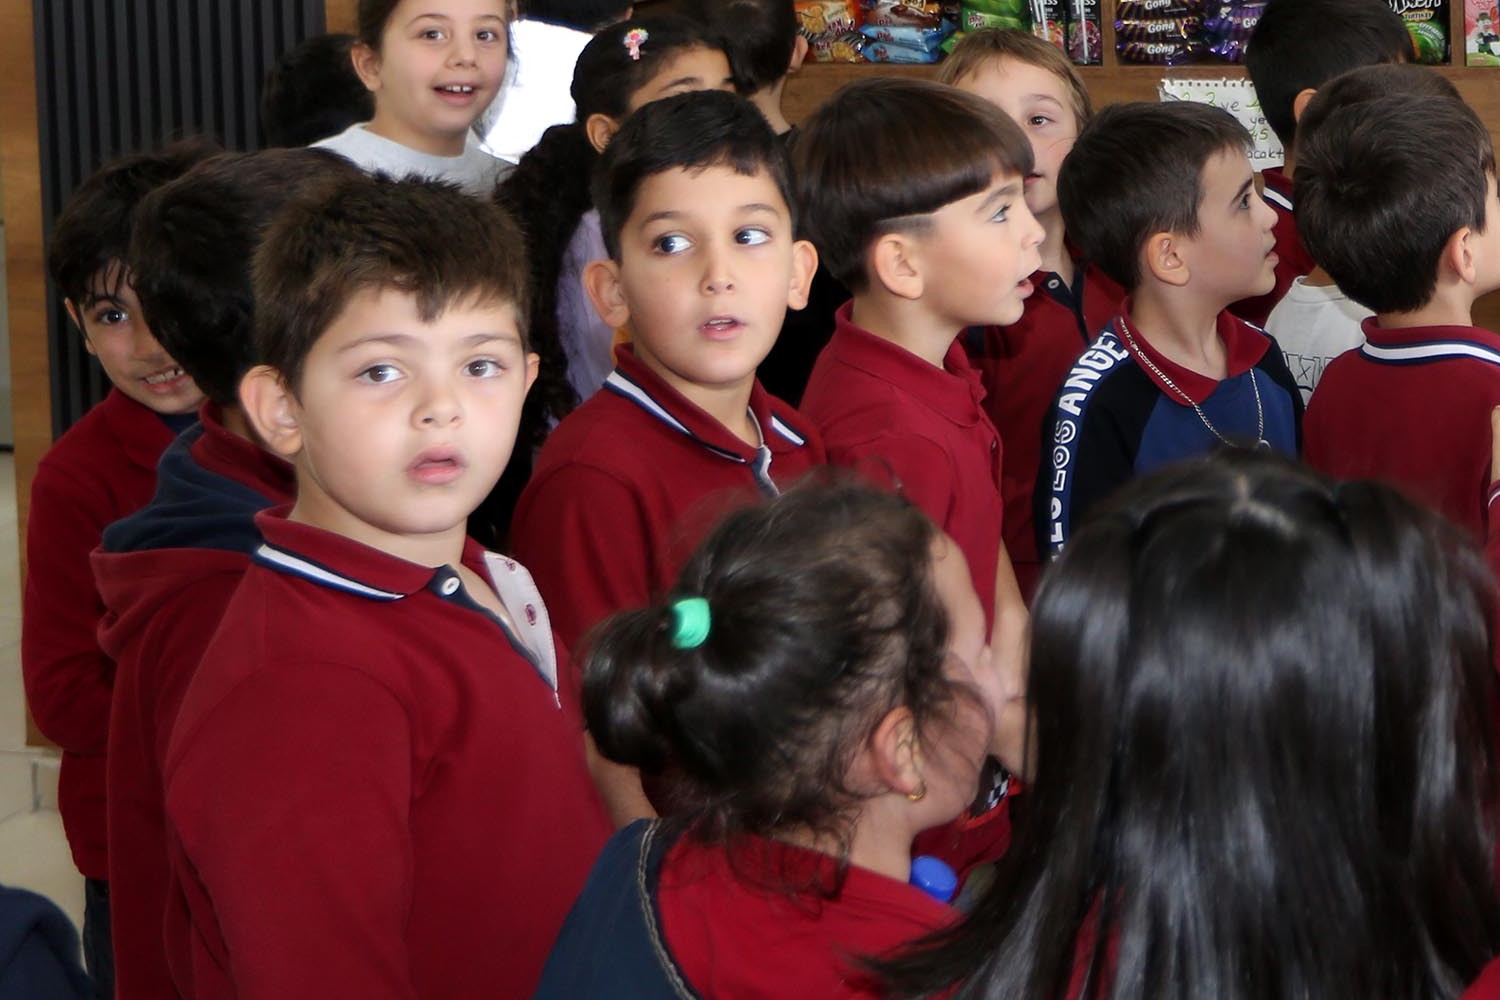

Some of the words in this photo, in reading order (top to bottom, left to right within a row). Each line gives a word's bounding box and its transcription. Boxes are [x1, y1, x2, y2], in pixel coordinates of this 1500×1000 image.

[1147, 21, 1176, 34] Gong
[1147, 43, 1176, 55] Gong
[1058, 331, 1130, 416] ANGE
